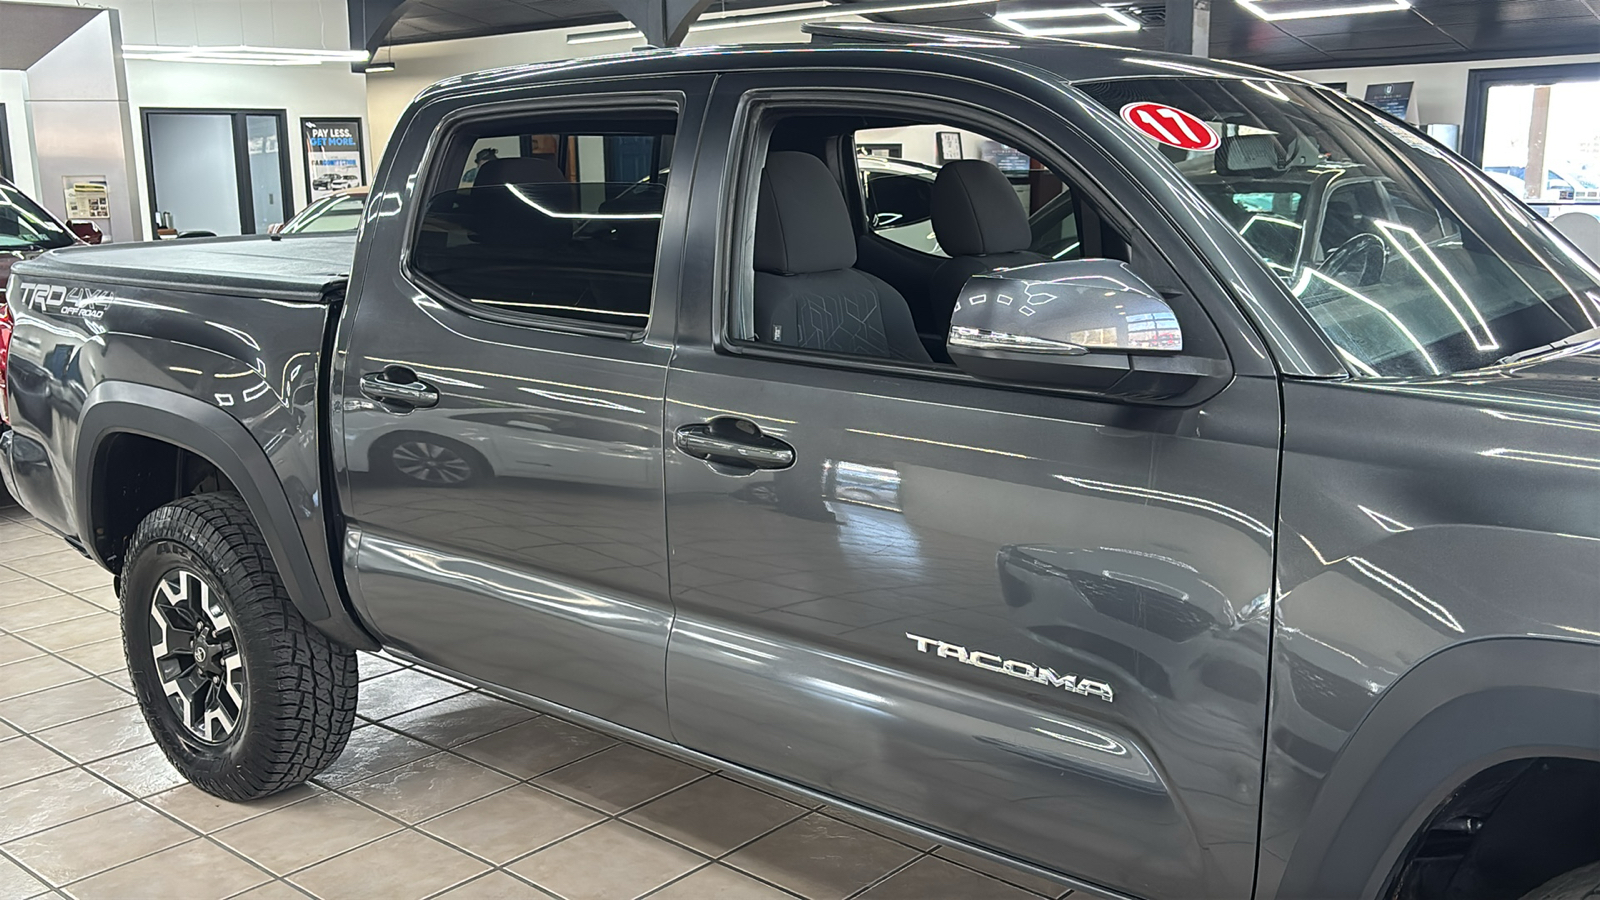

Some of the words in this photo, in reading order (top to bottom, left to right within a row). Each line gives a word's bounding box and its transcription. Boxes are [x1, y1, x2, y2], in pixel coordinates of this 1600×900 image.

[312, 128, 328, 138] PAY
[330, 128, 352, 138] LESS.
[1136, 108, 1201, 145] 17
[310, 137, 327, 146] GET
[328, 137, 356, 146] MORE.
[20, 282, 67, 311] TRD
[61, 306, 79, 315] OFF
[78, 307, 104, 318] ROAD
[905, 631, 1113, 703] TACOMA
